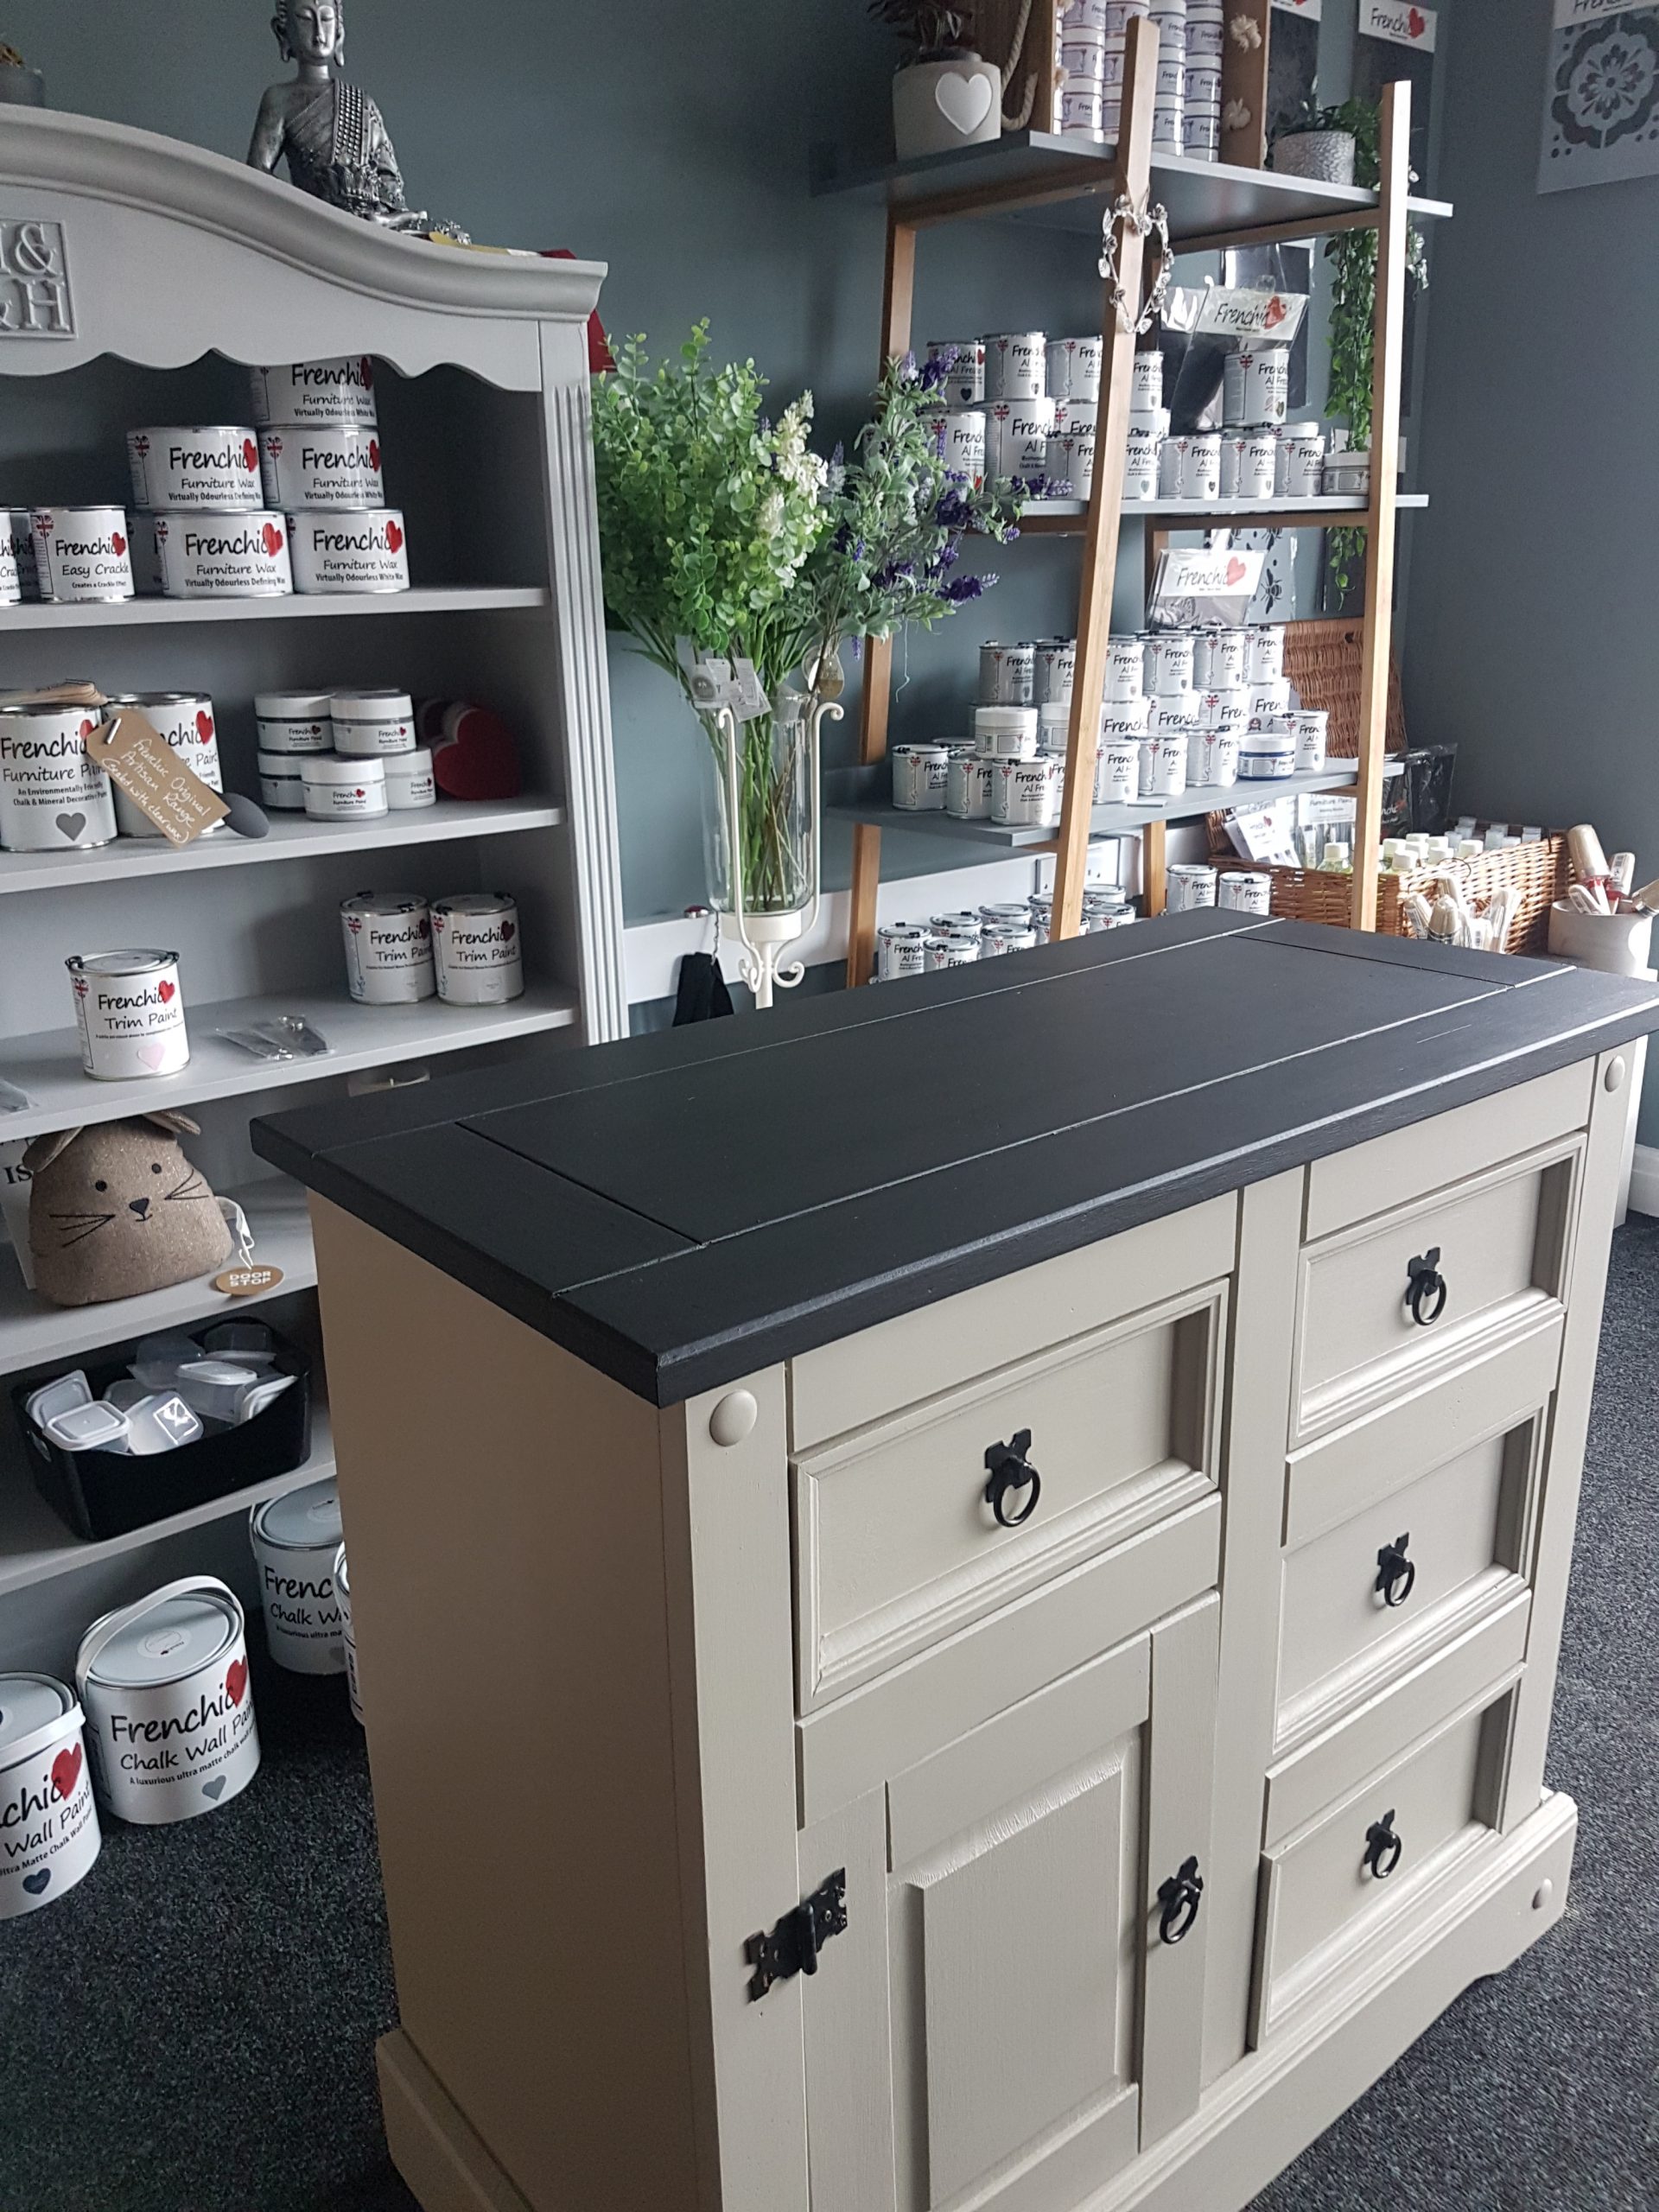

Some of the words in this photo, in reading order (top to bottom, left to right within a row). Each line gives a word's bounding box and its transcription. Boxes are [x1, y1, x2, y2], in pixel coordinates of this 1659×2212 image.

[294, 408, 324, 417] Virtually
[181, 478, 235, 489] Furniture
[238, 478, 255, 489] Wax
[168, 492, 200, 501] Virtually
[200, 492, 234, 501] Odourless
[305, 492, 335, 501] Virtually
[62, 564, 90, 578] Easy
[95, 562, 130, 574] Crackle
[196, 563, 252, 575] Furniture
[256, 563, 276, 574] Wax
[323, 559, 377, 571] Furniture
[379, 559, 397, 569] Wax
[185, 578, 214, 588] Virtually
[215, 577, 251, 587] Odourless
[315, 573, 346, 583] Virtually
[346, 572, 378, 582] Odourless
[161, 722, 203, 747] chic
[3, 766, 75, 781] Furniture
[28, 785, 83, 795] Environmentally
[120, 751, 159, 791] Artisan
[162, 792, 196, 829] Range
[1024, 784, 1033, 792] Al
[39, 797, 65, 805] Mineral
[130, 785, 149, 809] with
[172, 777, 211, 817] Original
[375, 950, 408, 963] Trim
[456, 950, 487, 963] Trim
[492, 944, 516, 960] Paint
[104, 1015, 143, 1029] Trim
[148, 1008, 177, 1026] Paint
[3, 1163, 33, 1185] IS
[229, 1270, 271, 1281] DOOR
[230, 1277, 271, 1287] STOP
[264, 1565, 334, 1599] Frenc
[270, 1602, 313, 1626] Chalk
[120, 1749, 179, 1770] Chalk
[185, 1725, 226, 1761] Wall
[137, 1776, 175, 1785] luxurious
[177, 1768, 198, 1781] ultra
[200, 1756, 223, 1774] matte
[224, 1744, 239, 1759] chalk
[0, 1774, 64, 1829] chic
[4, 1818, 54, 1859] Wall
[22, 1851, 48, 1871] Matte
[49, 1835, 70, 1855] Chalk
